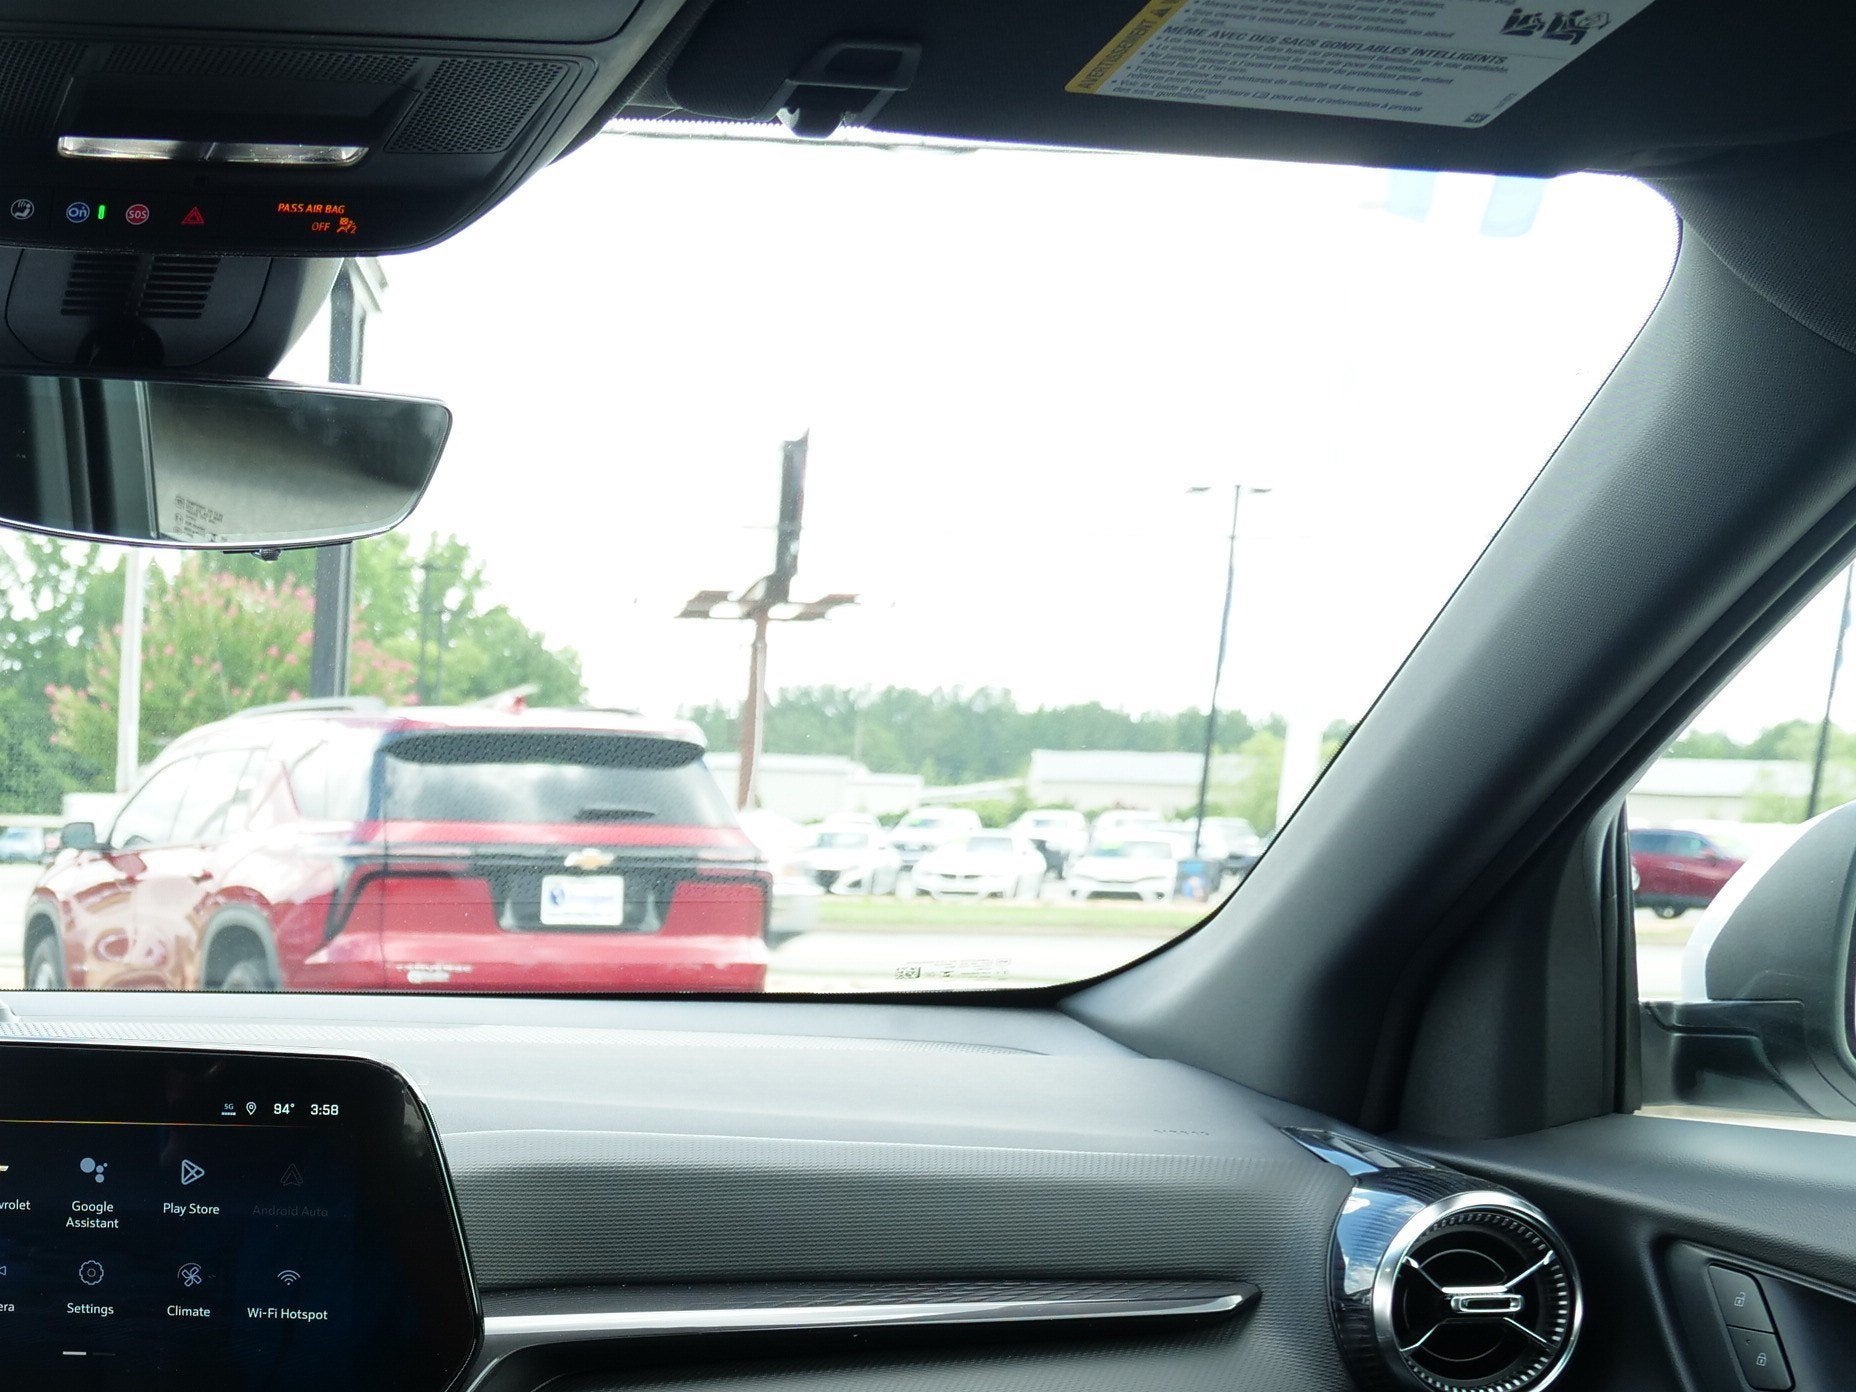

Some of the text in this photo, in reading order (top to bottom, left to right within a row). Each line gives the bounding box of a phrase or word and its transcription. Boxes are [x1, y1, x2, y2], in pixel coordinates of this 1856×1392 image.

[1163, 25, 1508, 64] MÊME AVEC DES SACS GONFLABLES INTELLIGENTS
[128, 209, 147, 219] SOS
[277, 203, 345, 214] PASS AIR BAG
[311, 222, 330, 232] OFF
[273, 1103, 295, 1115] 94°
[310, 1104, 339, 1116] 3:58
[71, 1201, 114, 1213] Google
[163, 1203, 220, 1216] Play Store
[253, 1205, 329, 1217] Android Auto
[66, 1217, 119, 1229] Assistant
[67, 1303, 114, 1316] Settings
[167, 1305, 211, 1317] Climate
[247, 1307, 328, 1323] Wi-Fi Hotspot
